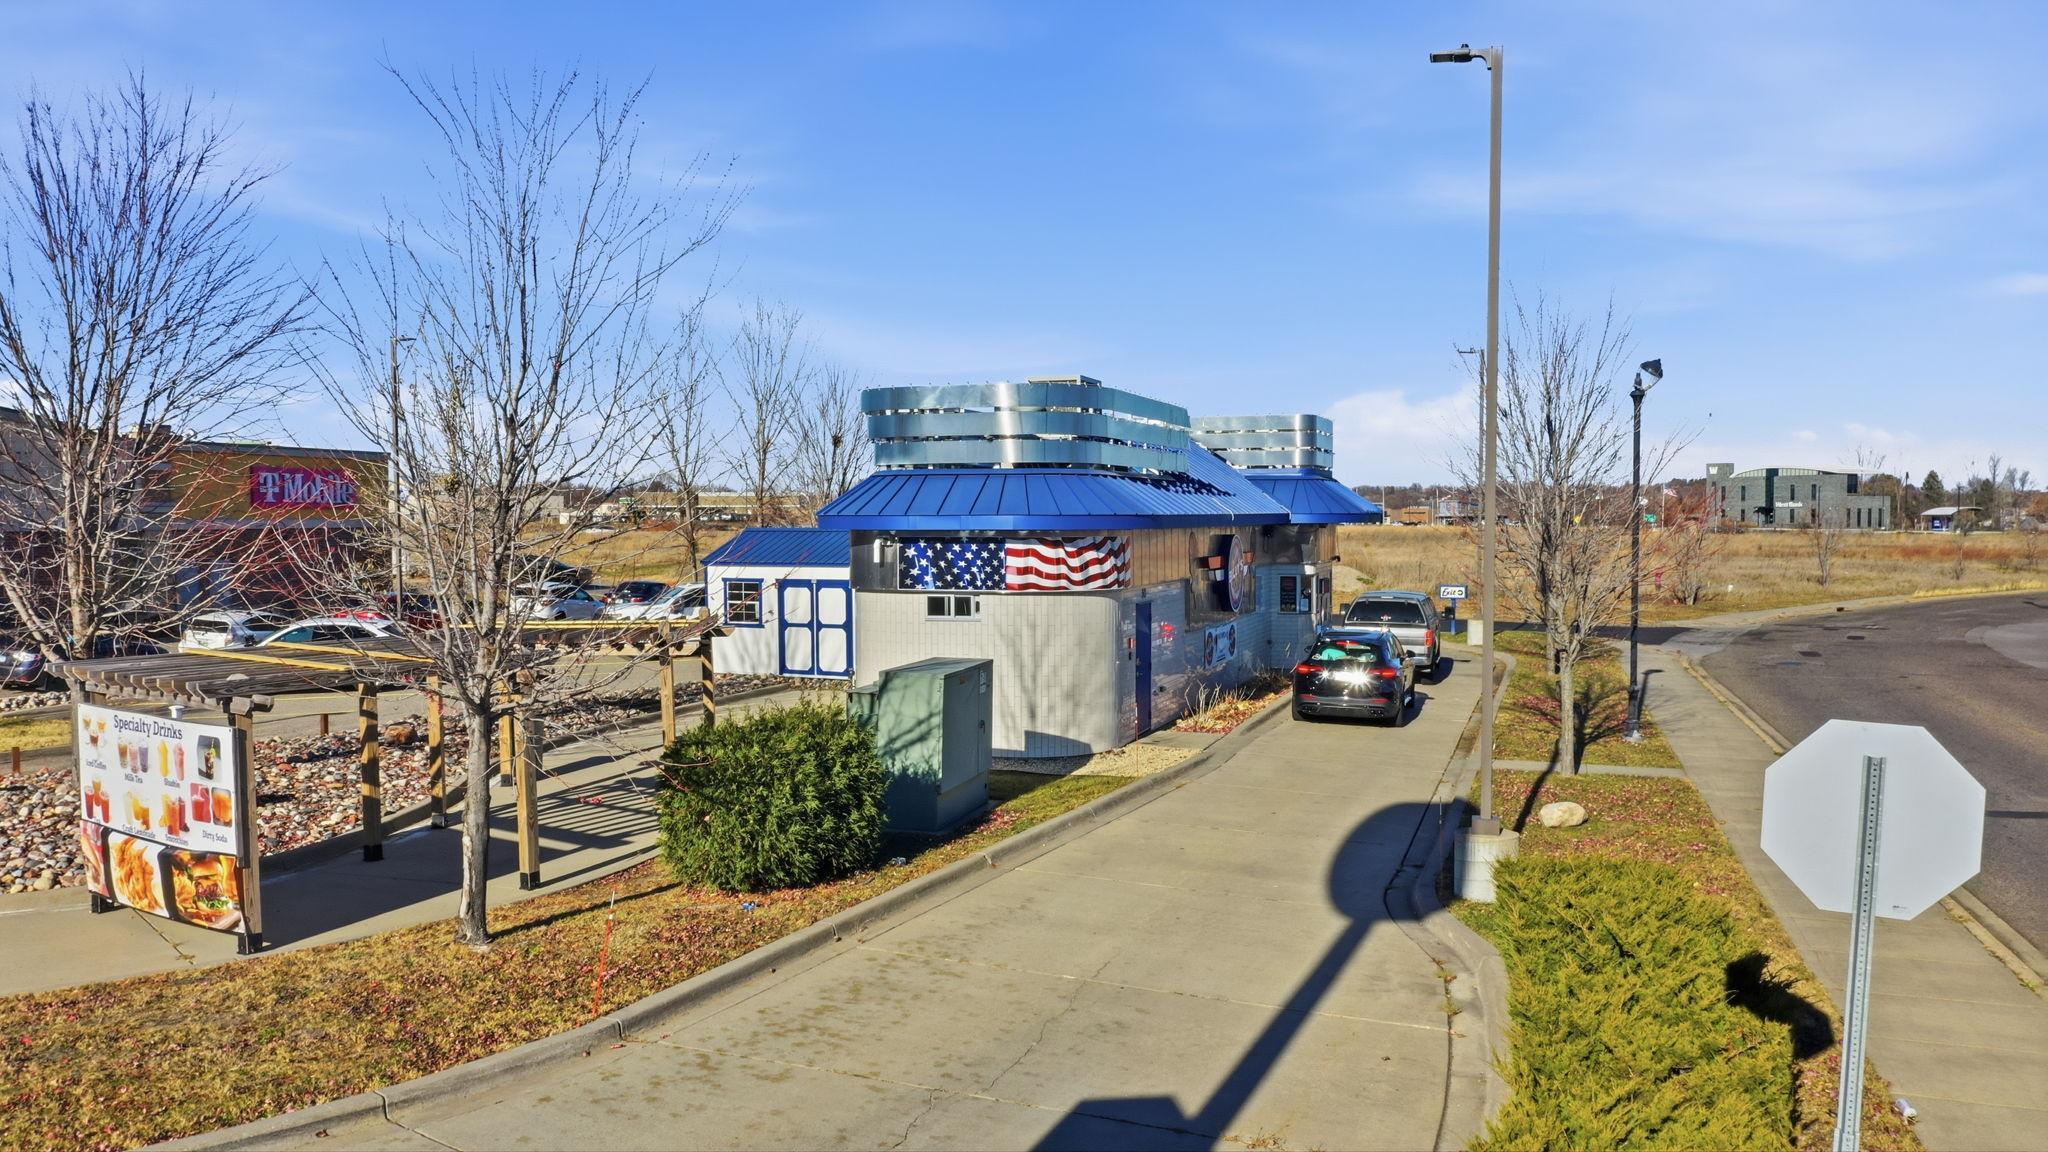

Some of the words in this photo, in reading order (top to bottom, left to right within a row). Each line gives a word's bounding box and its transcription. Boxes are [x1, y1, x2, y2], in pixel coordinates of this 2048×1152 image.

[1442, 588, 1456, 596] Exit
[113, 714, 151, 738] Specialty
[152, 720, 183, 740] Drinks
[124, 772, 135, 783] Milk
[135, 774, 143, 784] Tea
[215, 833, 227, 842] Soda
